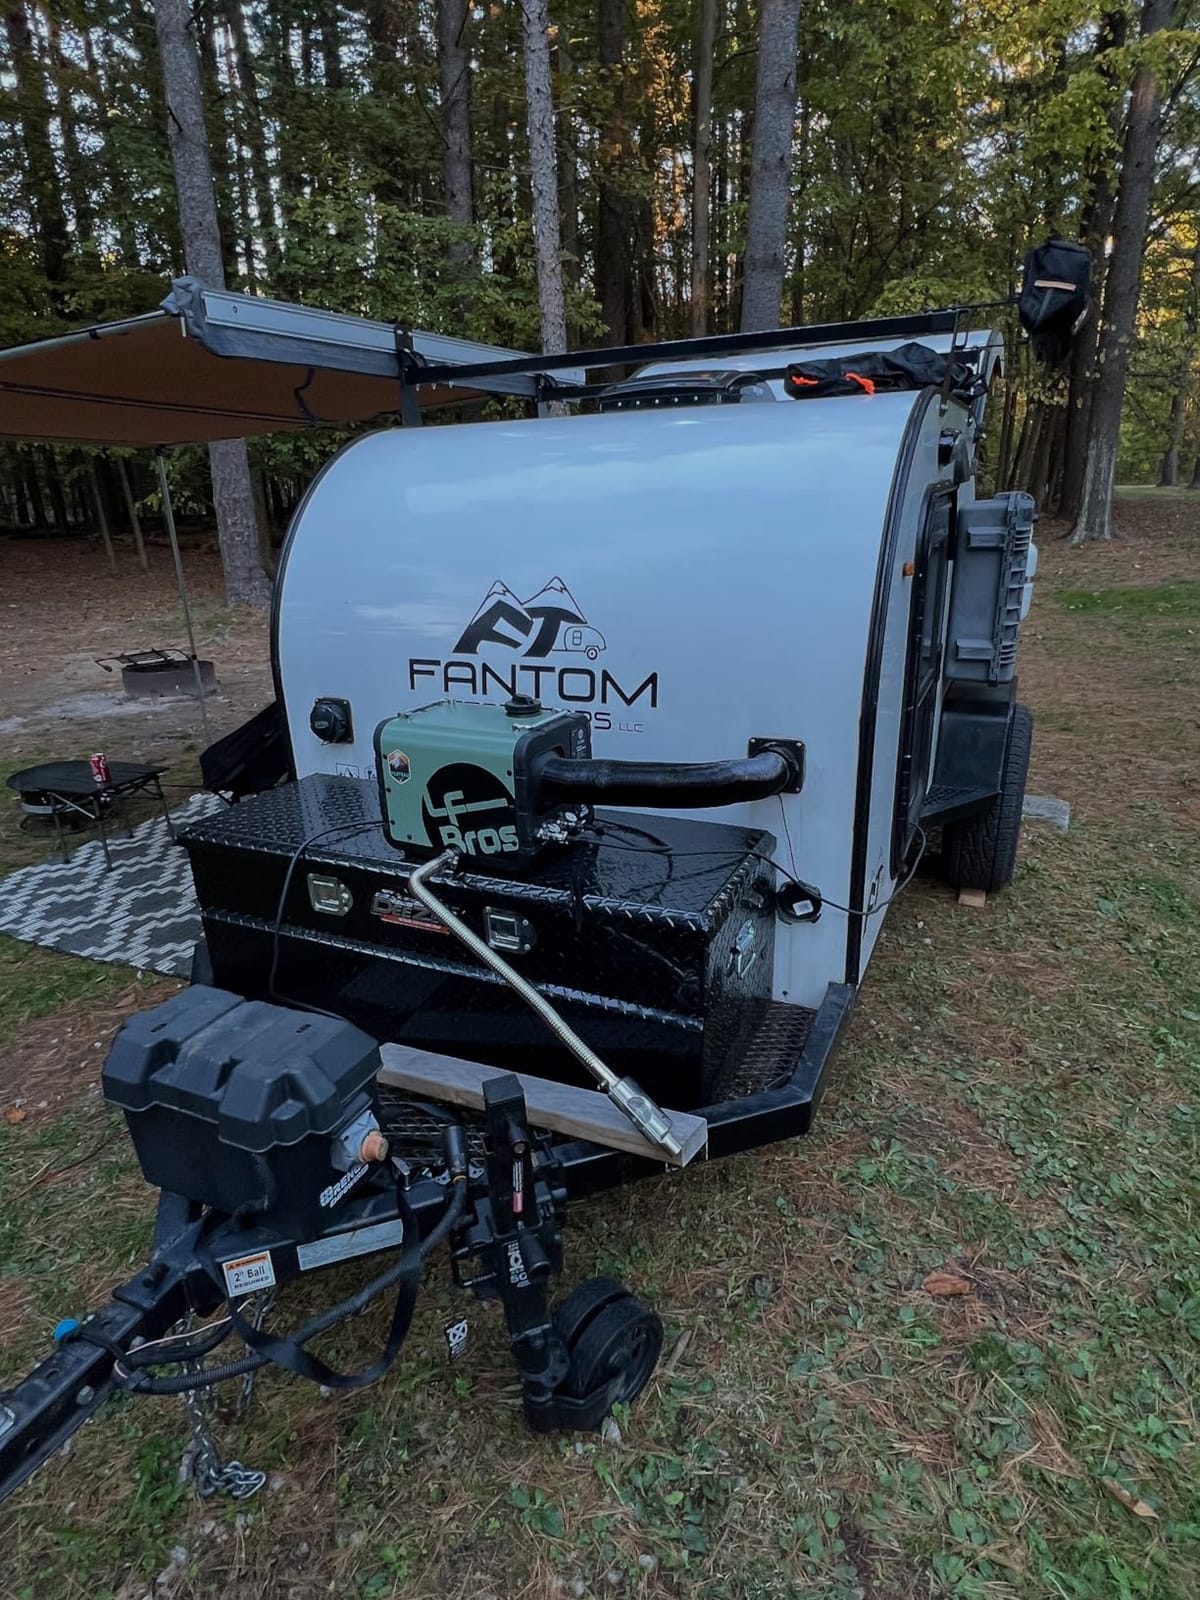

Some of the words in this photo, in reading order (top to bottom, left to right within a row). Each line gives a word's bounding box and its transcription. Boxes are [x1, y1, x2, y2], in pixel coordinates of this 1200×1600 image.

[408, 657, 658, 709] FANTOM
[618, 721, 645, 733] LLC
[438, 825, 519, 856] Bros
[247, 1265, 266, 1279] Ball
